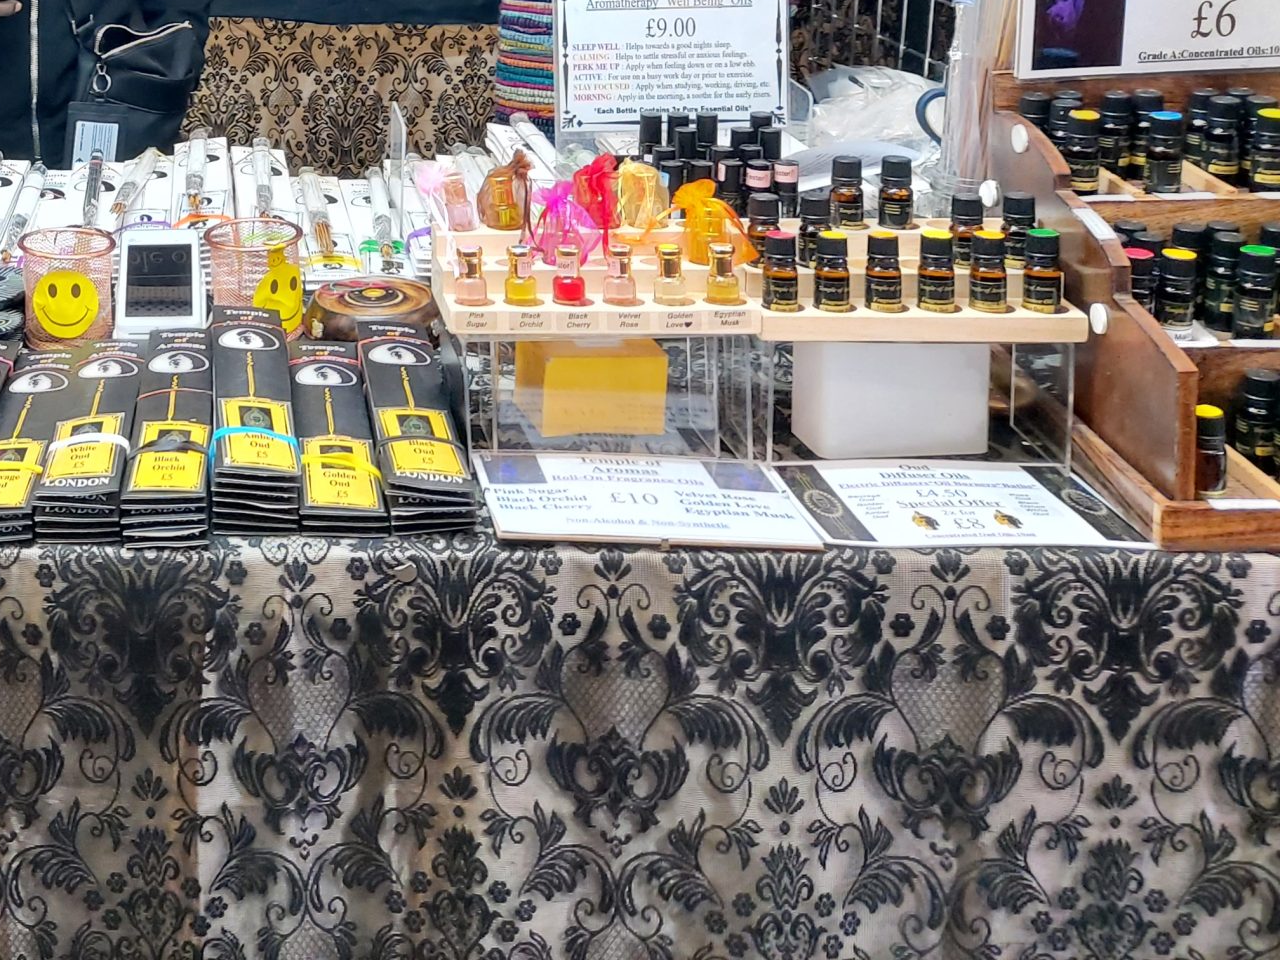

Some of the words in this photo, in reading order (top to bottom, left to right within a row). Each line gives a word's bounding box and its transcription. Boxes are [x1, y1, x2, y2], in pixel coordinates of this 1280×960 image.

[1190, 0, 1238, 39] £6
[645, 17, 696, 38] £9.00
[572, 43, 596, 51] SLEEP
[598, 43, 620, 51] WELL
[626, 43, 643, 52] Helps
[645, 42, 669, 50] towards
[677, 41, 692, 50] good
[693, 41, 712, 50] nights
[615, 53, 633, 61] Helps
[1138, 51, 1168, 61] Grade
[573, 63, 593, 71] PERK
[626, 63, 644, 71] Apply
[687, 61, 704, 69] down
[573, 73, 603, 81] ACTIVE
[608, 73, 618, 81] For
[647, 73, 661, 82] busy
[680, 72, 691, 81] day
[702, 72, 717, 80] prior
[636, 83, 654, 92] Apply
[617, 93, 638, 102] Apply
[646, 92, 656, 100] the
[725, 91, 734, 99] the
[223, 308, 270, 318] Temple
[714, 310, 746, 319] Egyptian
[566, 321, 591, 329] Cherry
[159, 331, 205, 339] Temple
[156, 342, 207, 350] Aromas
[70, 445, 96, 453] White
[413, 447, 435, 456] Oud
[154, 455, 180, 463] Black
[256, 451, 269, 459] £5
[592, 466, 658, 475] Aromas
[161, 473, 174, 481] £5
[323, 471, 357, 480] Golden
[396, 471, 464, 484] LONDON
[879, 471, 937, 480] Diffuser
[941, 472, 971, 480] Oils
[44, 477, 110, 488] LONDON
[329, 479, 351, 488] Oud
[607, 475, 675, 484] Fragrance
[678, 478, 704, 486] Oils
[839, 482, 880, 490] Electric
[336, 490, 349, 499] £5
[674, 490, 717, 499] Velvet
[721, 493, 757, 502] Rose
[916, 489, 968, 498] £4.50
[611, 492, 658, 505] £10
[679, 498, 731, 508] Golden
[735, 501, 771, 510] Love
[896, 500, 954, 510] Special
[959, 499, 1002, 508] Offer
[685, 507, 750, 518] Egyptian
[755, 511, 796, 520] Musk
[954, 518, 986, 530] £8
